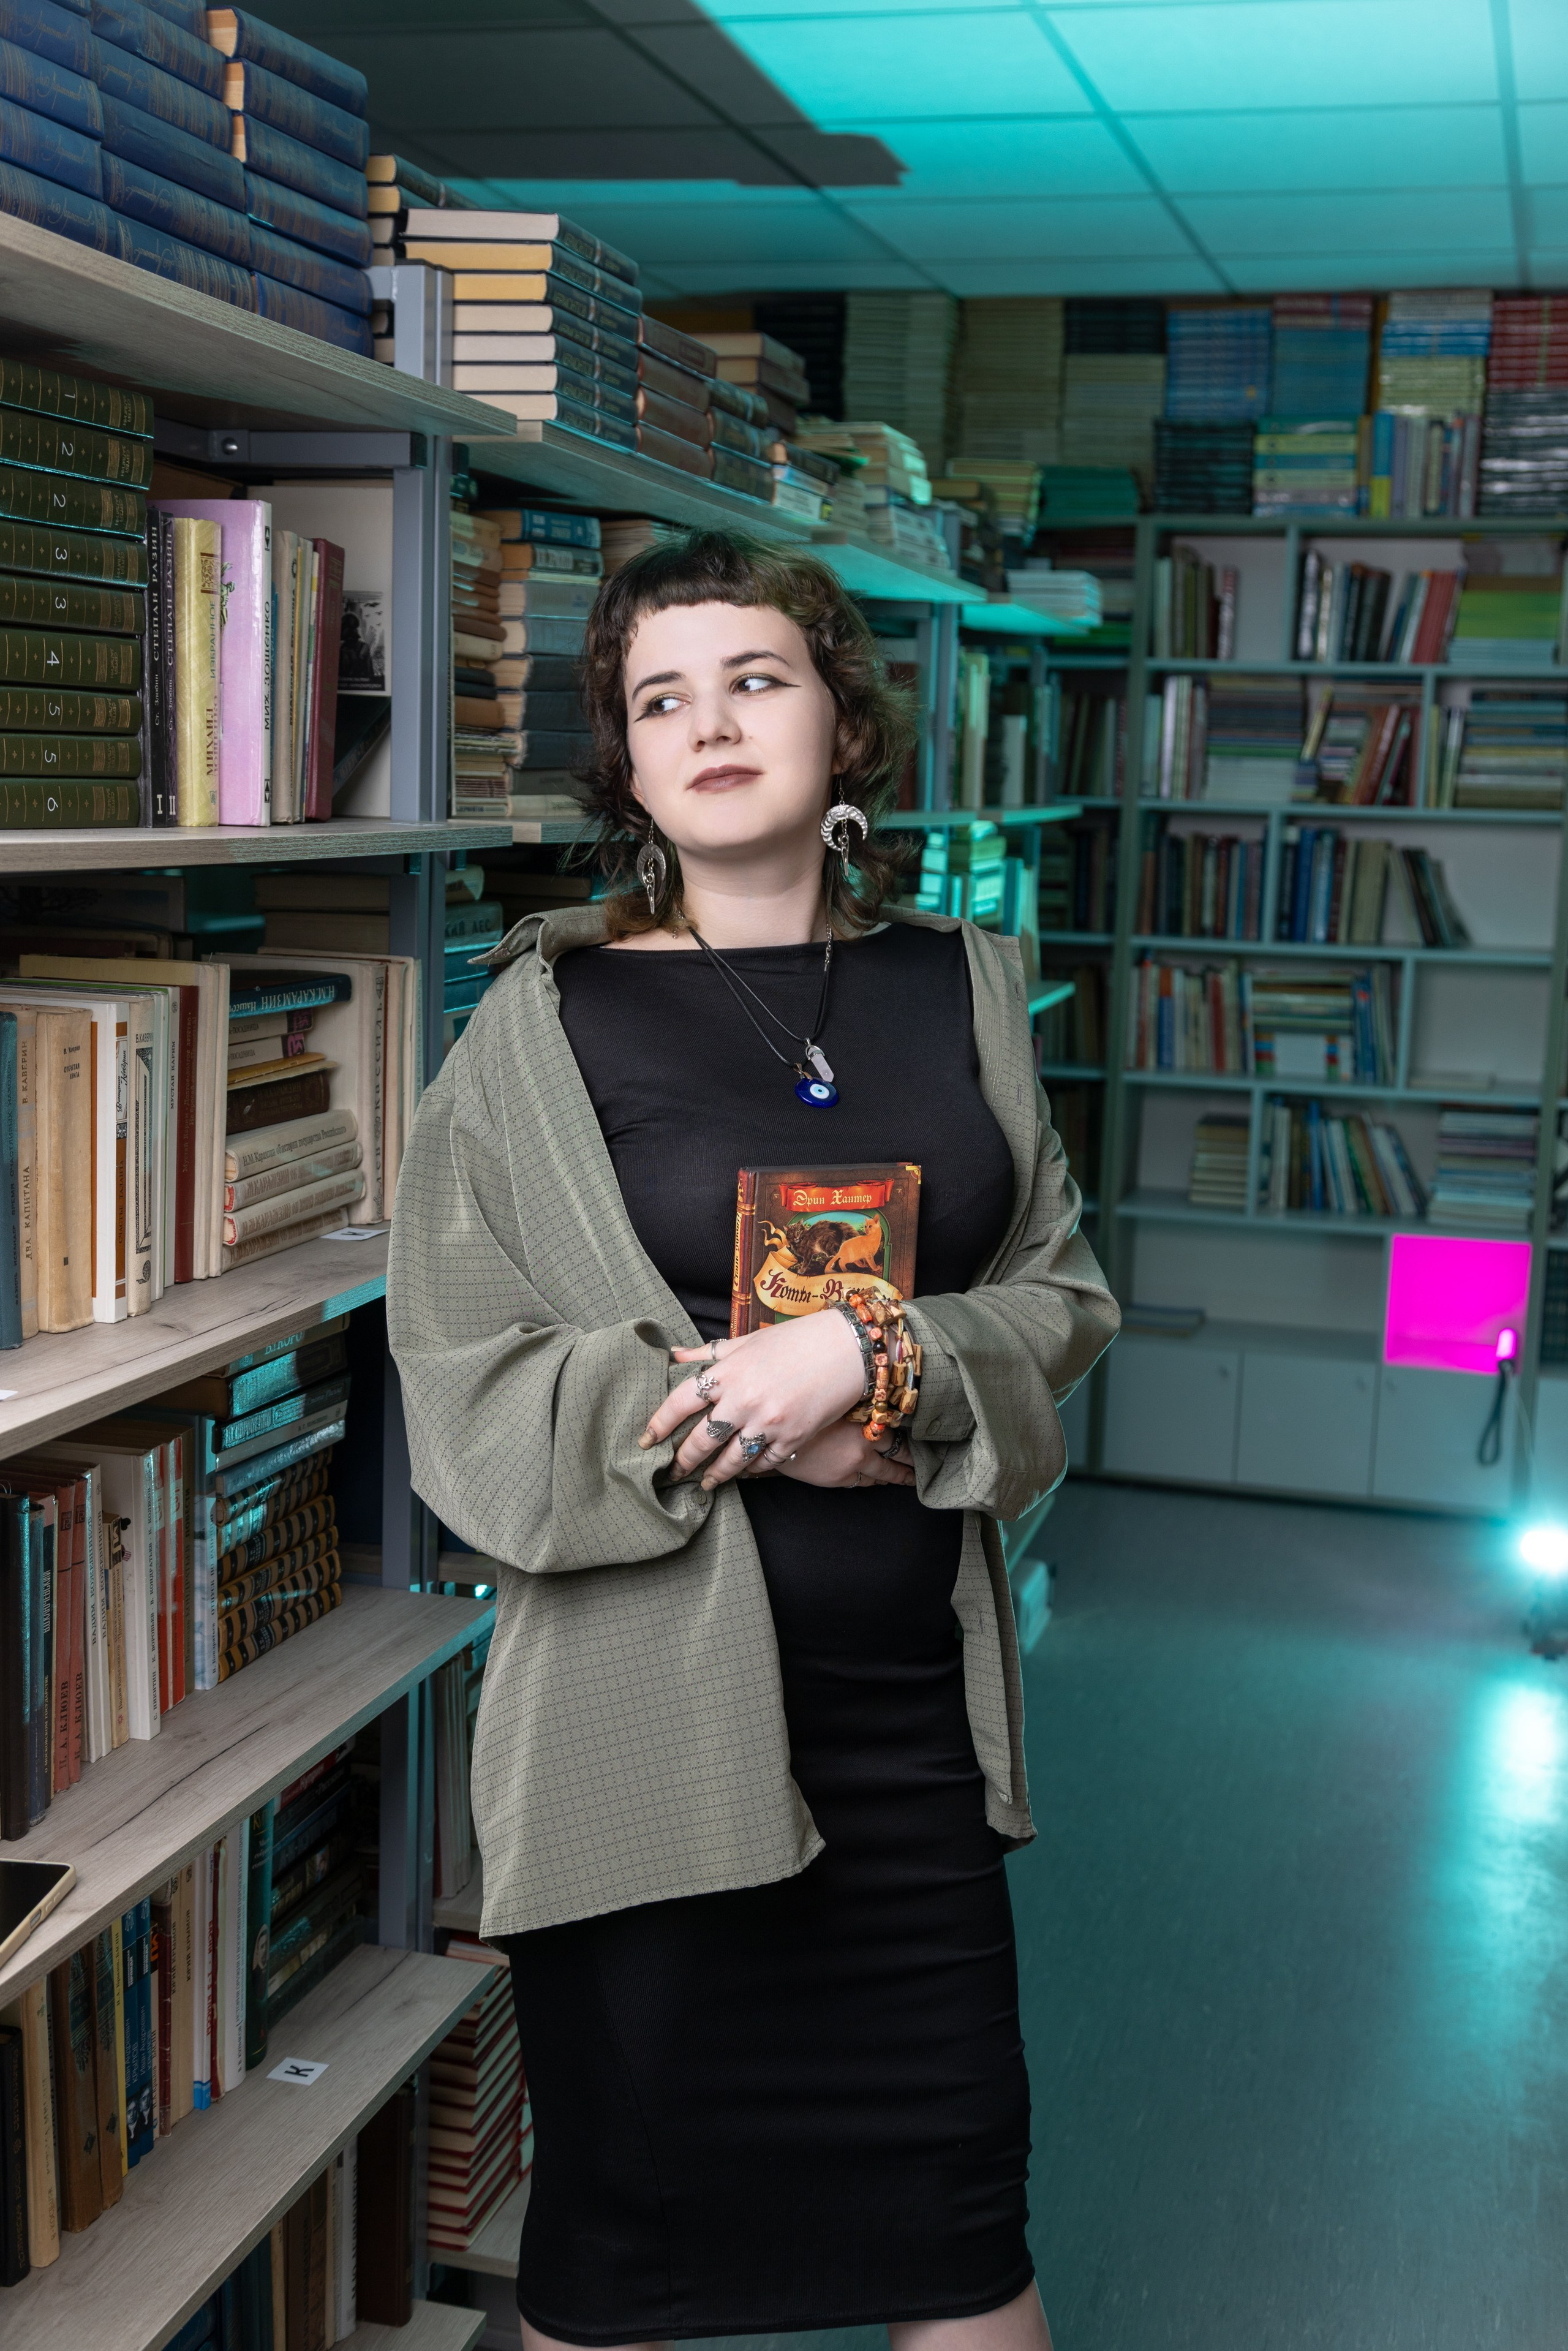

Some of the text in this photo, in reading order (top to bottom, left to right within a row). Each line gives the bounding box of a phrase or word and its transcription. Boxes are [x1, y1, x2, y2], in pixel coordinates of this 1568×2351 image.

[61, 441, 74, 456] 2
[54, 493, 66, 507] 2
[55, 547, 67, 560] 3
[55, 597, 67, 609] 3
[47, 651, 60, 665] 4
[49, 703, 60, 715] 5
[45, 750, 56, 763] 5
[47, 798, 58, 812] 6
[69, 1044, 80, 1054] Каверин
[64, 1063, 80, 1073] ОТКРЫТАЯ
[22, 1095, 28, 1104] В.
[322, 1126, 347, 1140] Российского
[793, 1189, 872, 1207] Эрин Хантер
[148, 1526, 153, 1535] К.
[210, 1563, 216, 1576] ПО
[59, 1680, 68, 1732] КЛЮЕВ
[75, 1727, 81, 1740] А.
[60, 1738, 67, 1749] А.
